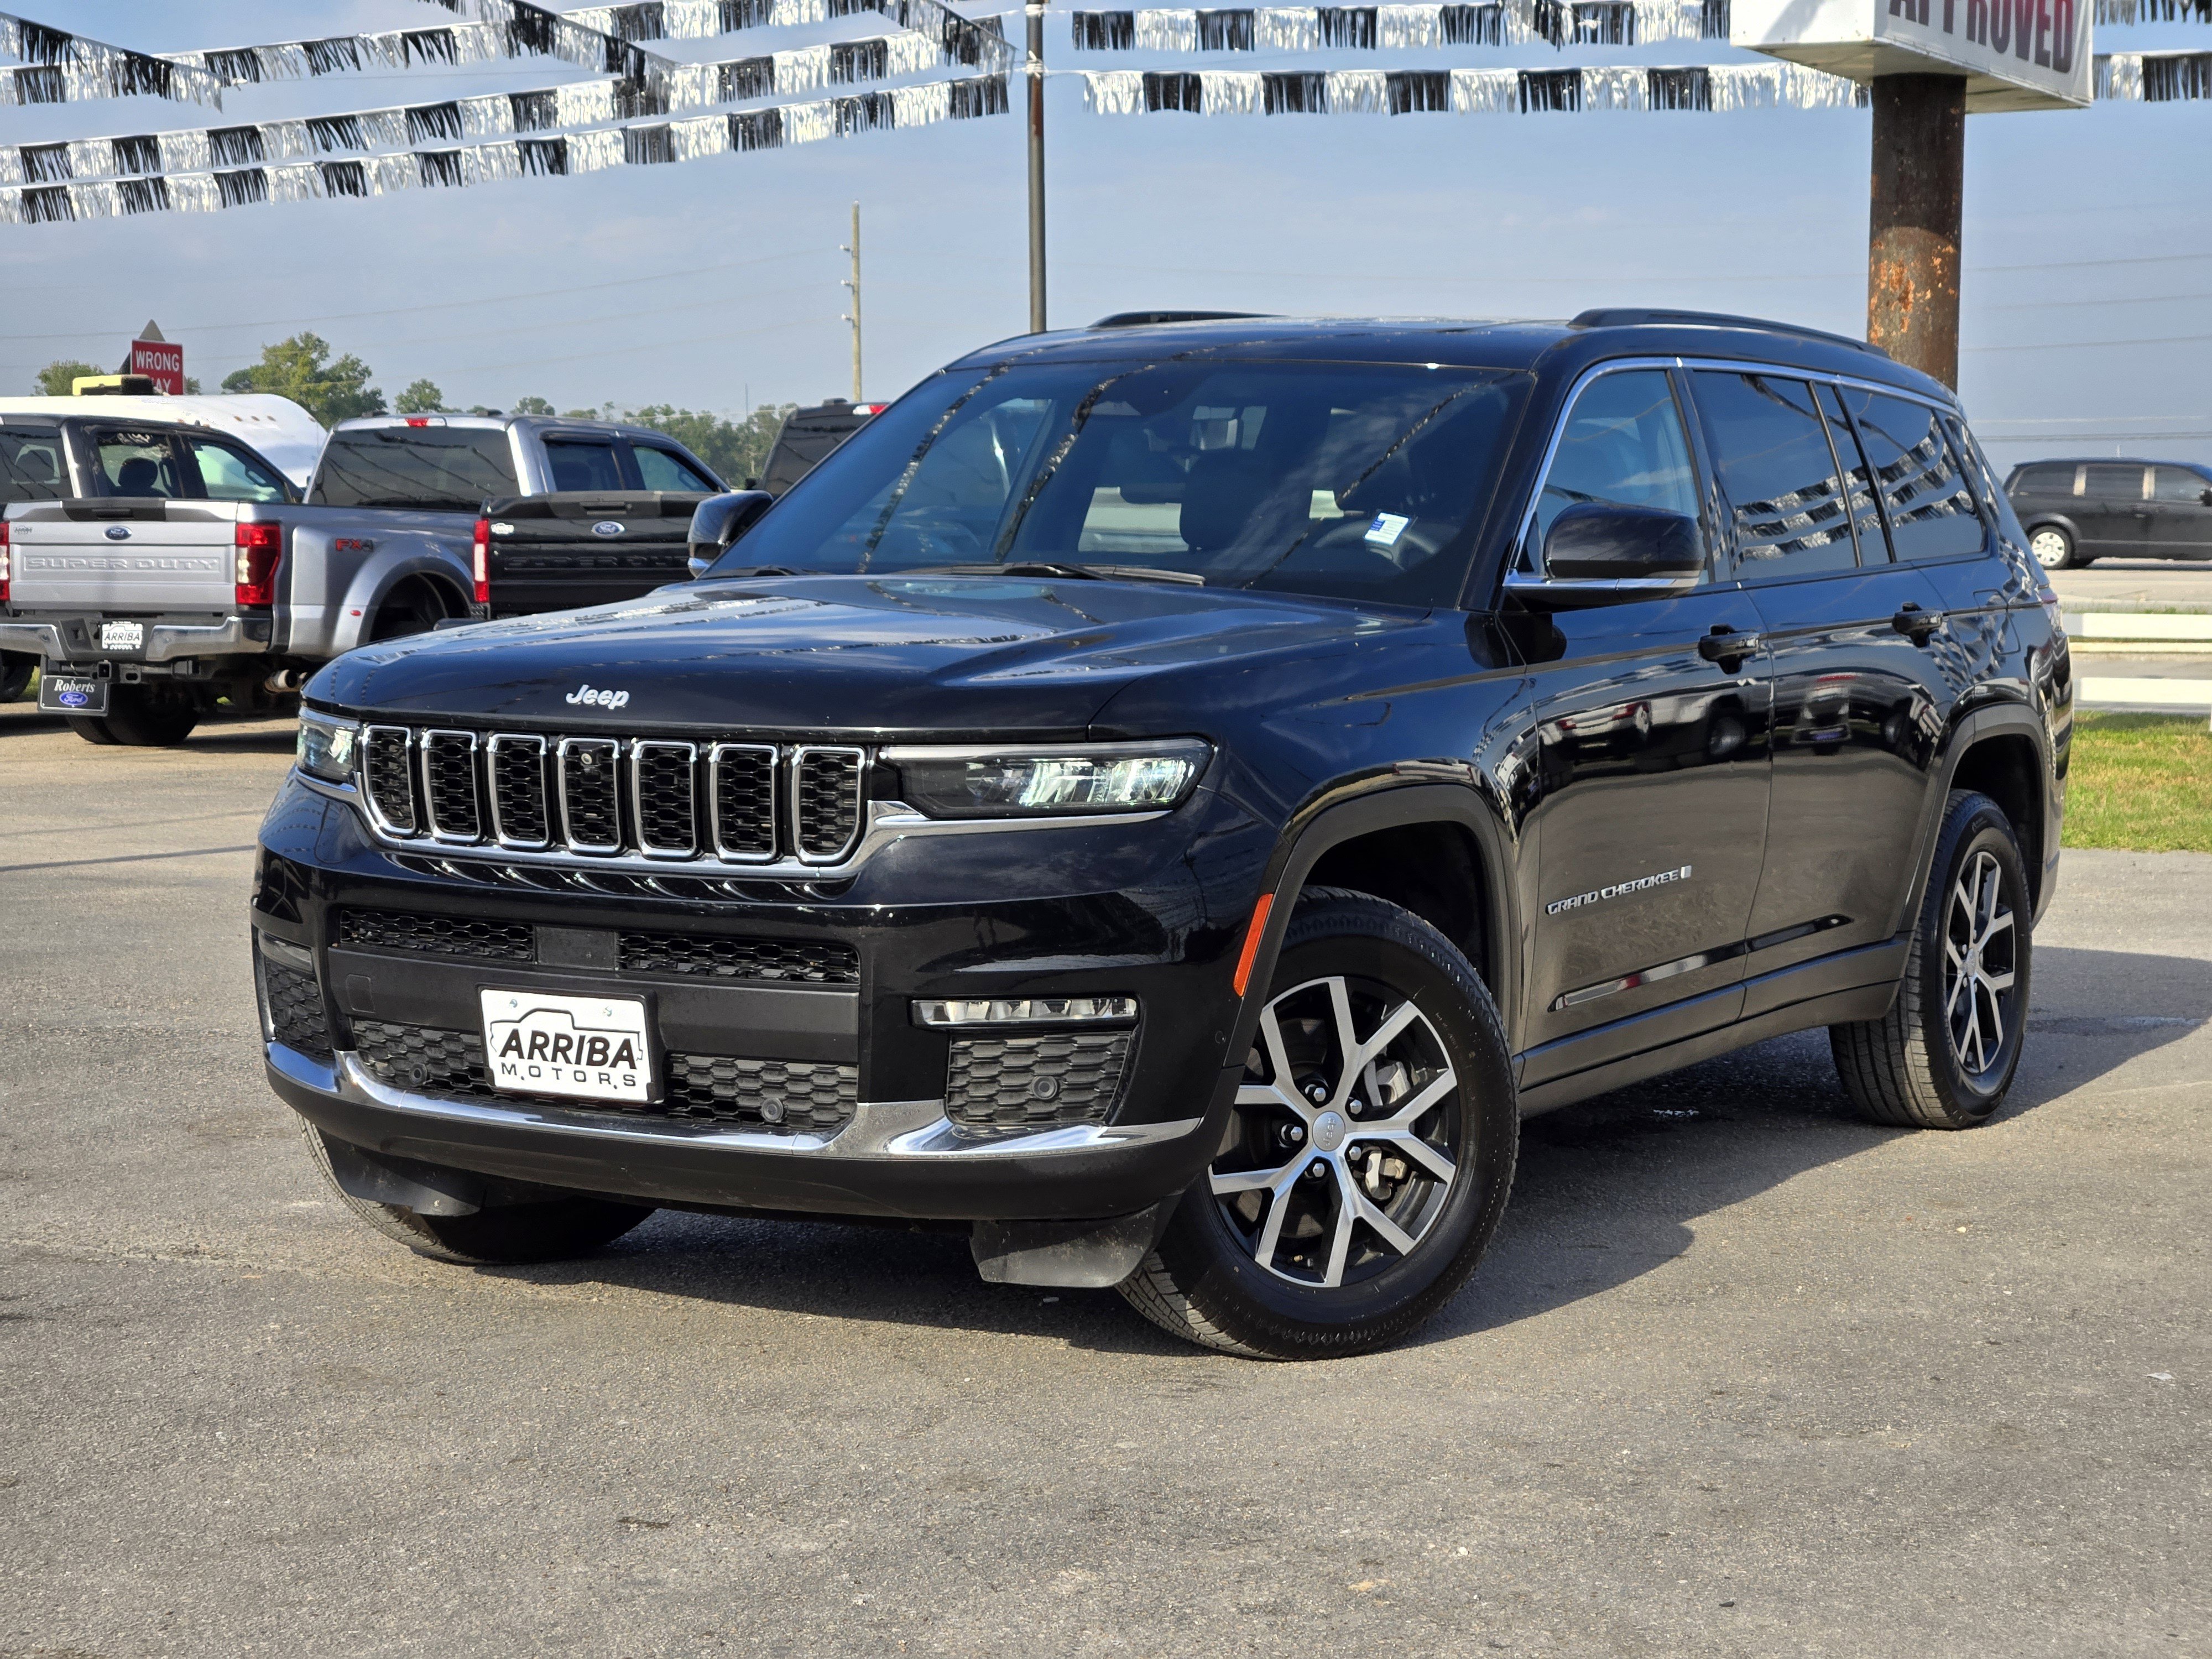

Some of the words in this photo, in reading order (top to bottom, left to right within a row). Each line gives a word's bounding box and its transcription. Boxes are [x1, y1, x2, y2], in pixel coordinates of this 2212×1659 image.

[1888, 0, 2074, 74] ROVED
[135, 349, 180, 372] WRONG
[151, 377, 171, 394] AY
[335, 539, 374, 552] FX4
[27, 557, 128, 569] SUPER
[134, 558, 218, 570] DUTY
[104, 632, 140, 641] ARRIBA
[54, 679, 96, 693] Roberts
[565, 684, 630, 710] Jeep
[64, 693, 84, 703] Ford
[1546, 891, 1599, 915] GRAND
[1600, 869, 1679, 899] CHEROKEE
[498, 1028, 638, 1070] ARRIBA
[500, 1062, 637, 1087] MOTORS
[1322, 1117, 1337, 1146] Jeep
